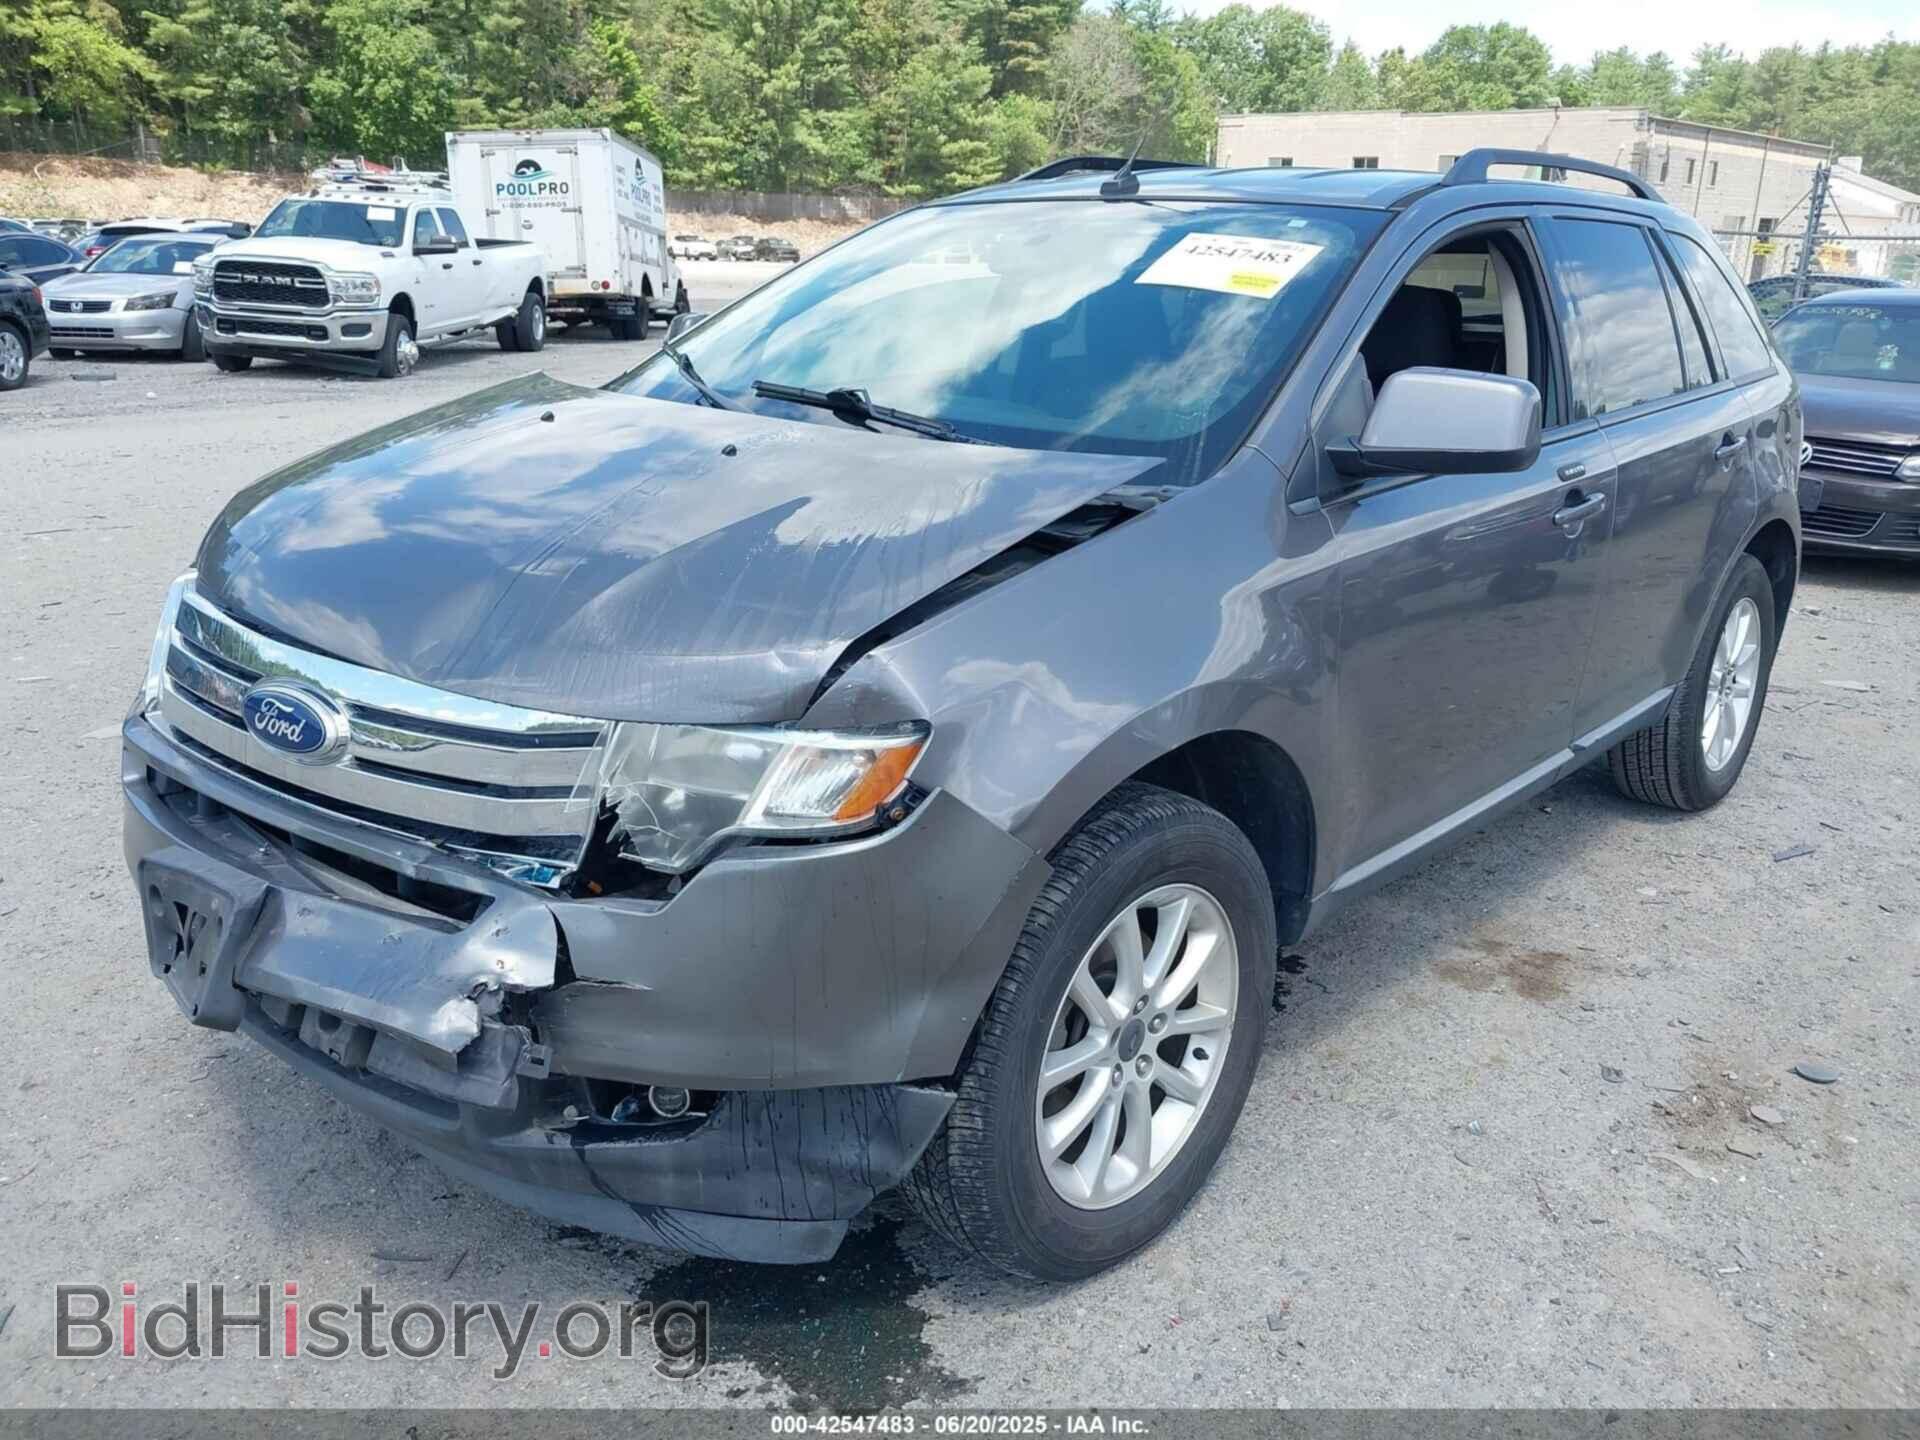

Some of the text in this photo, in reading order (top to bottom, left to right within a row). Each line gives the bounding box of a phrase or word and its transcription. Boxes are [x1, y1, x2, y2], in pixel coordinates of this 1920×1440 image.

[495, 182, 569, 196] POOLPRO
[1184, 245, 1293, 264] 42547483
[243, 274, 293, 287] RAM
[254, 697, 304, 742] Ford
